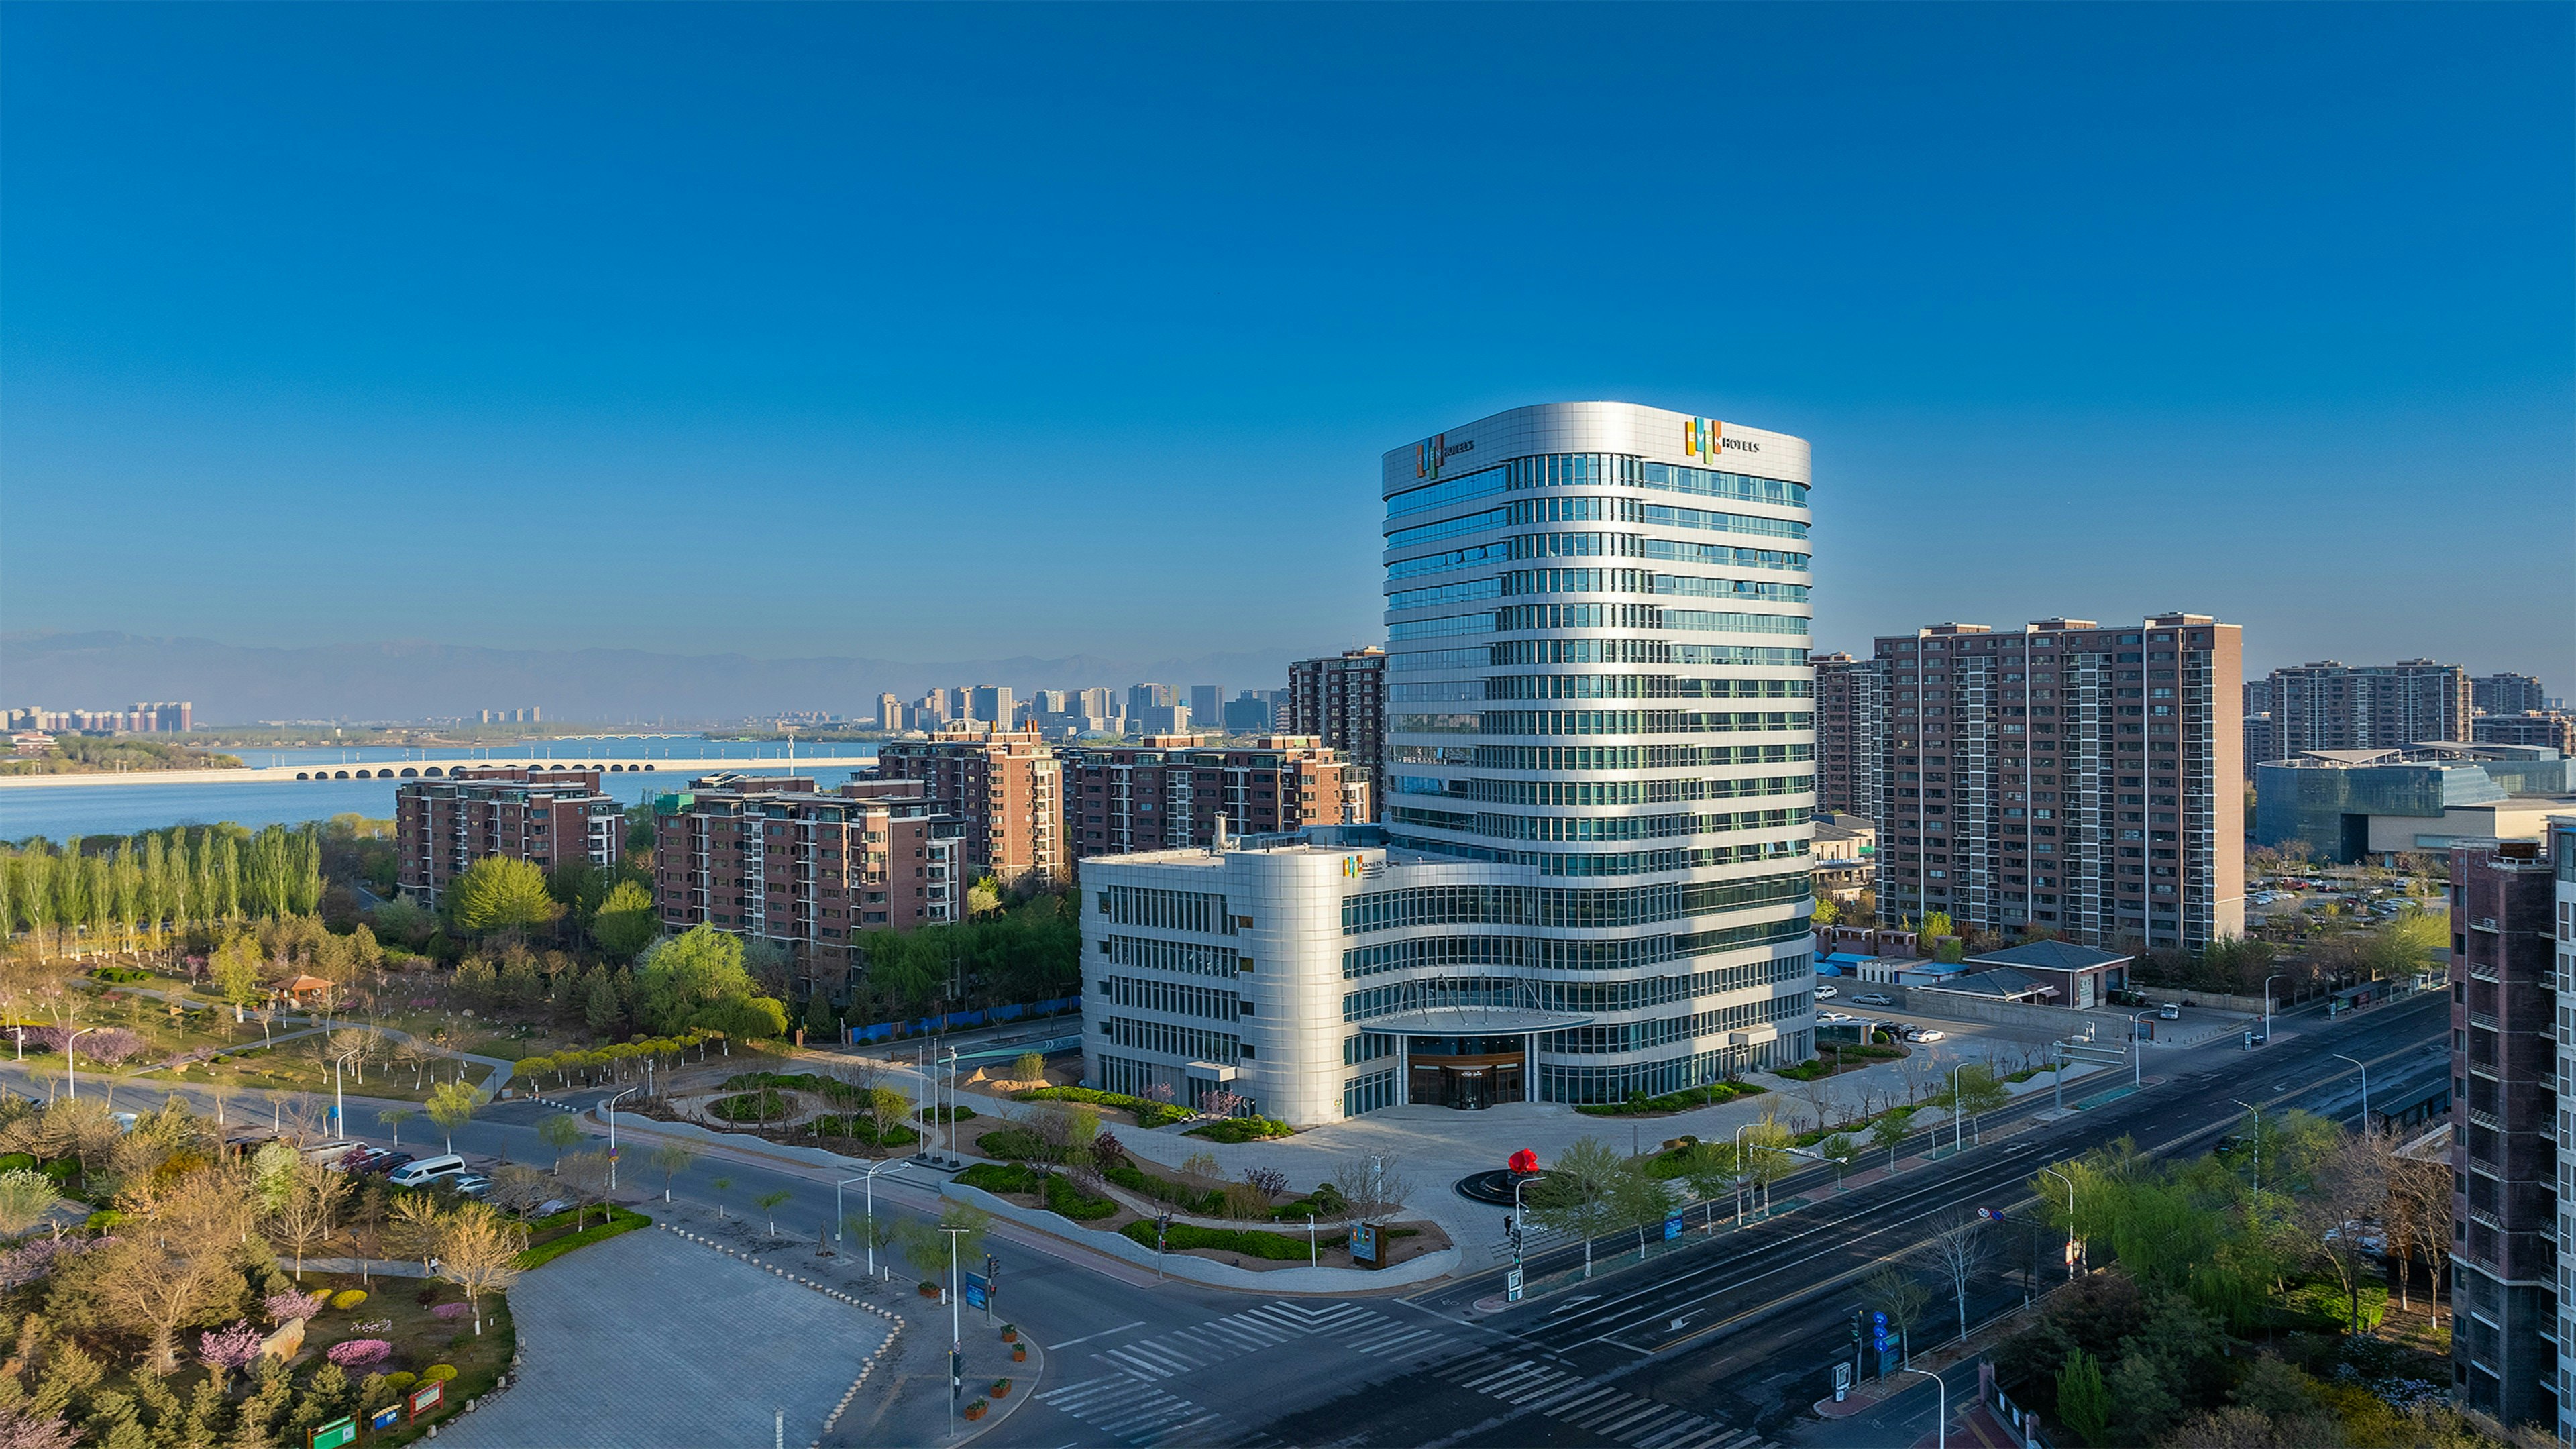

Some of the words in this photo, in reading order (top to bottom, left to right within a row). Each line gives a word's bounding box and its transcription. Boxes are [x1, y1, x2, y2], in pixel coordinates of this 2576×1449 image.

[1417, 448, 1442, 464] EVEN
[1444, 440, 1475, 458] HOTELS
[1687, 431, 1721, 446] EVEN
[1722, 437, 1760, 453] HOTELS
